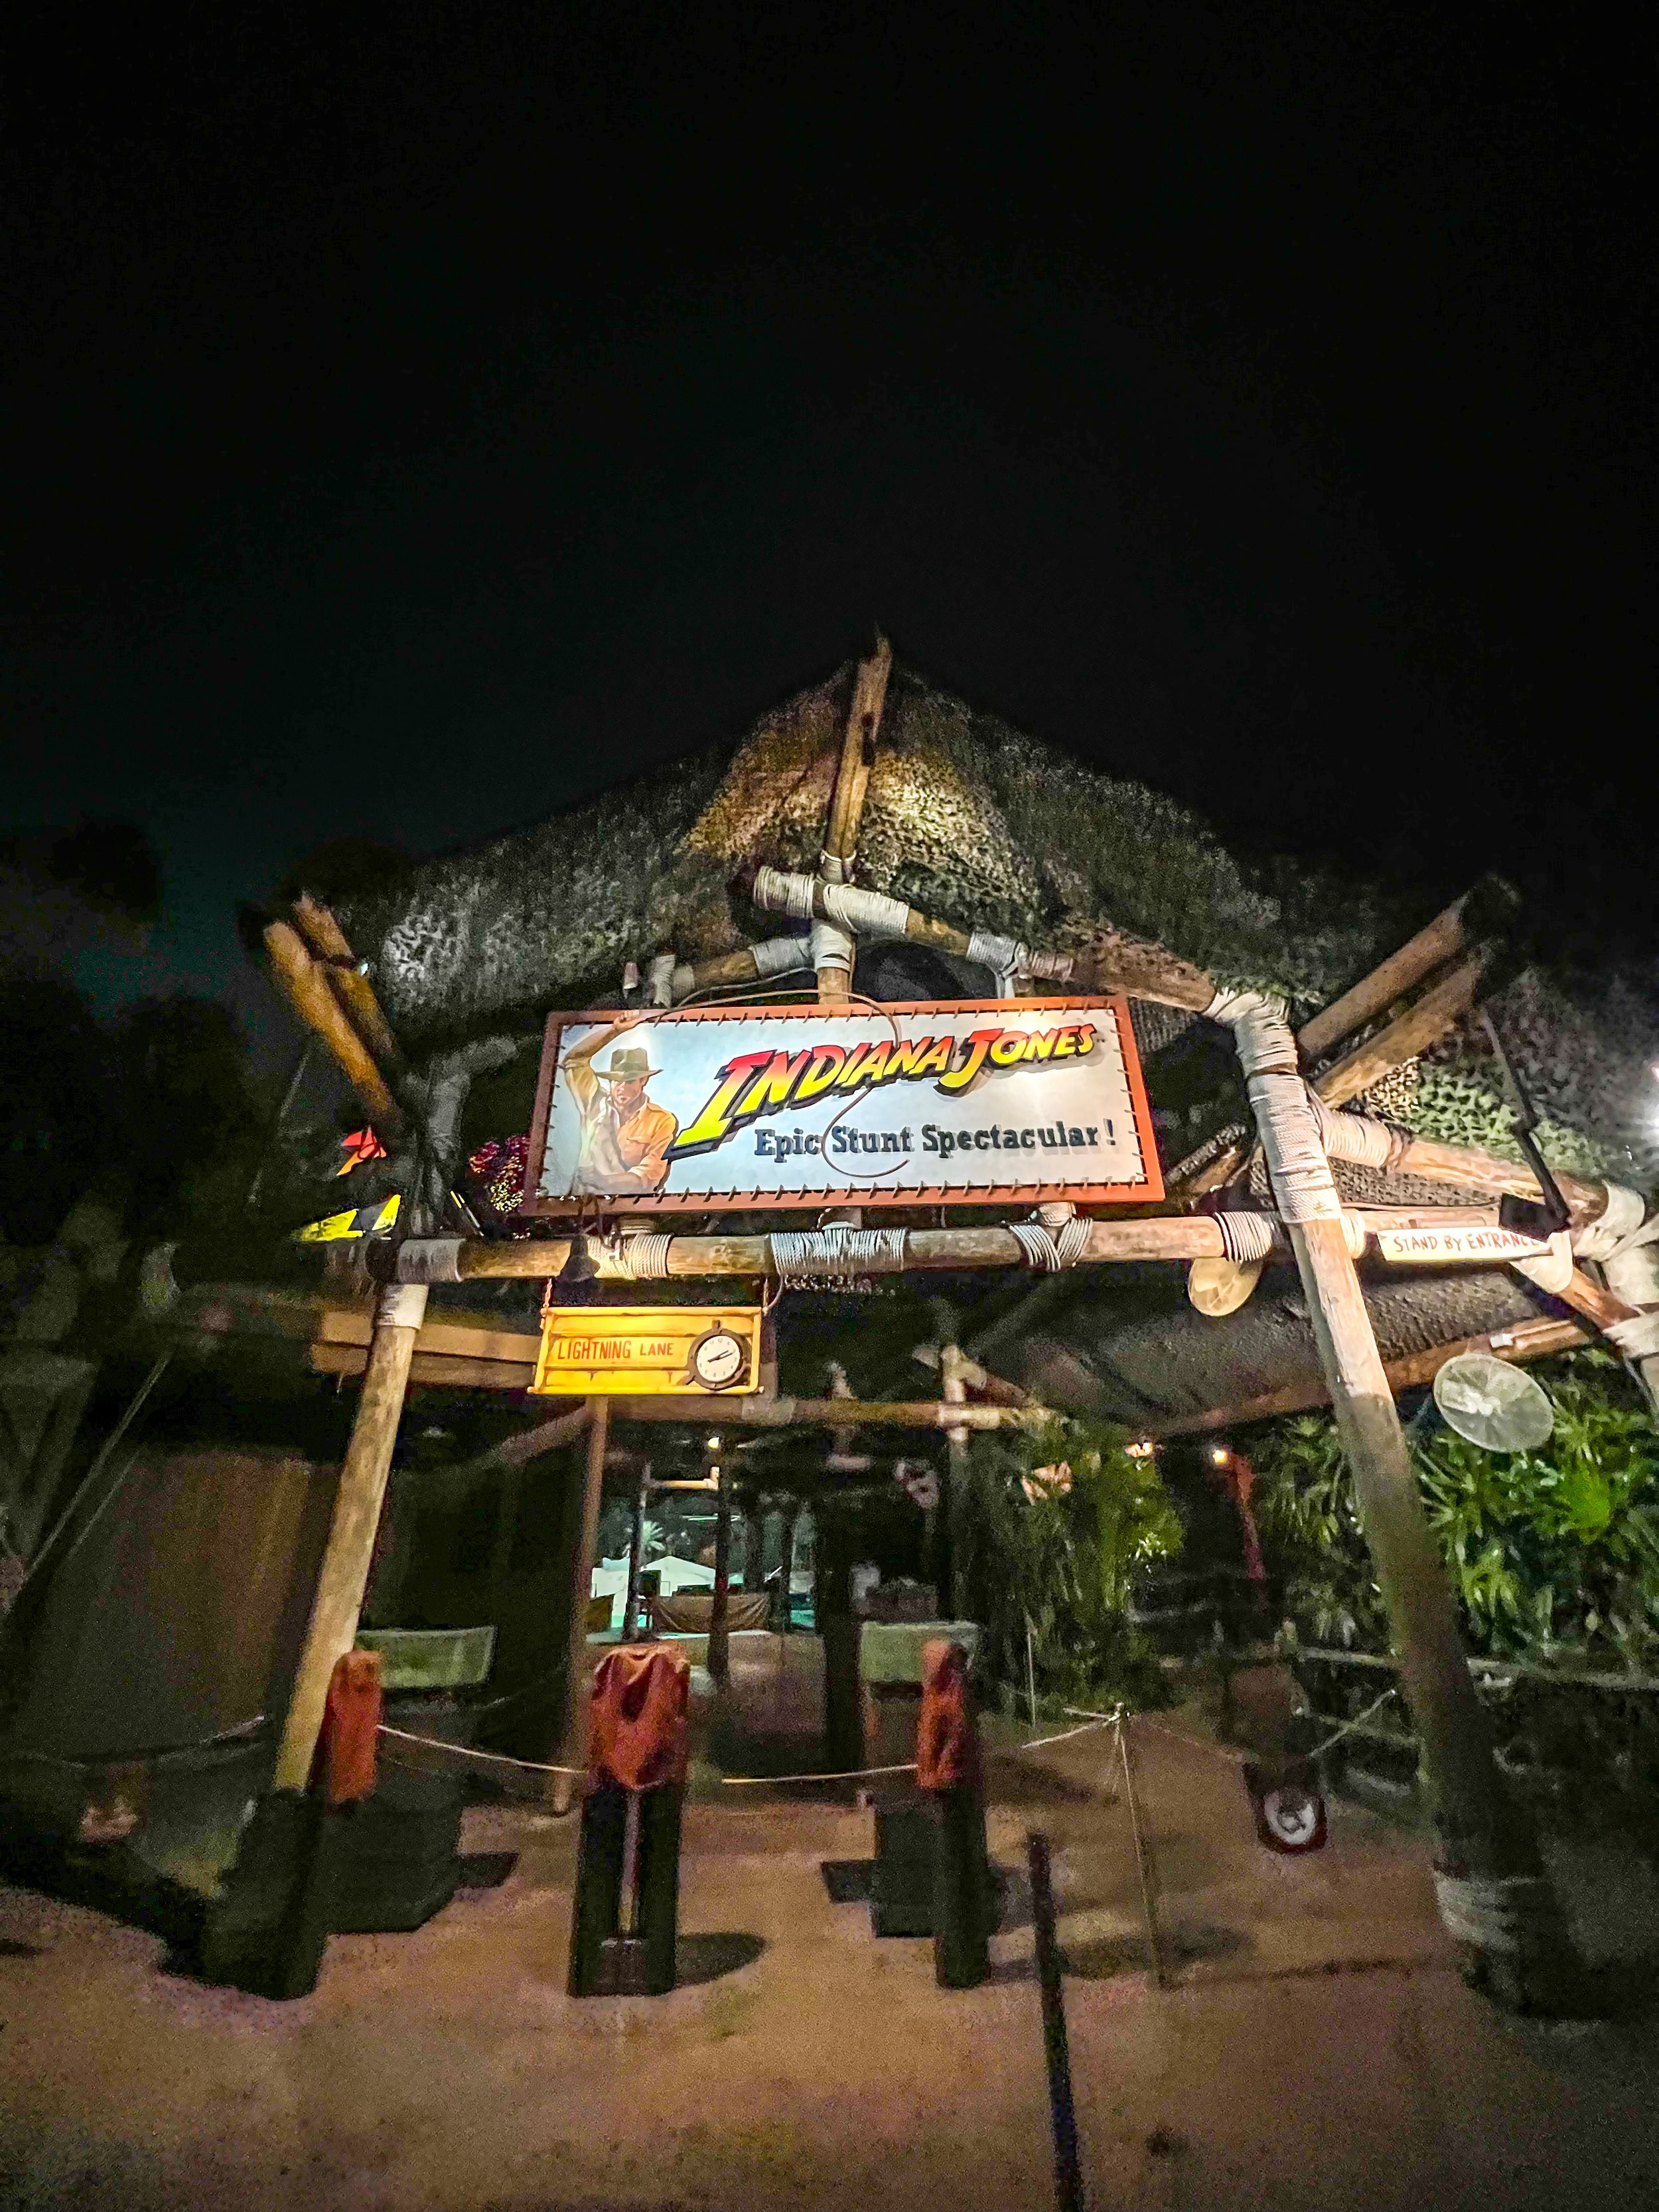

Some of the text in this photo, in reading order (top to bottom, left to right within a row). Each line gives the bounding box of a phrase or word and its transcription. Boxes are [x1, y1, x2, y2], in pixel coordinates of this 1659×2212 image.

[666, 1023, 1097, 1159] INDIANA JONES
[754, 1128, 823, 1163] Epic
[831, 1125, 914, 1153] Stunt
[1394, 1236, 1438, 1253] STAND
[1443, 1235, 1461, 1252] BY
[557, 1341, 674, 1360] LIGHTNING LANE
